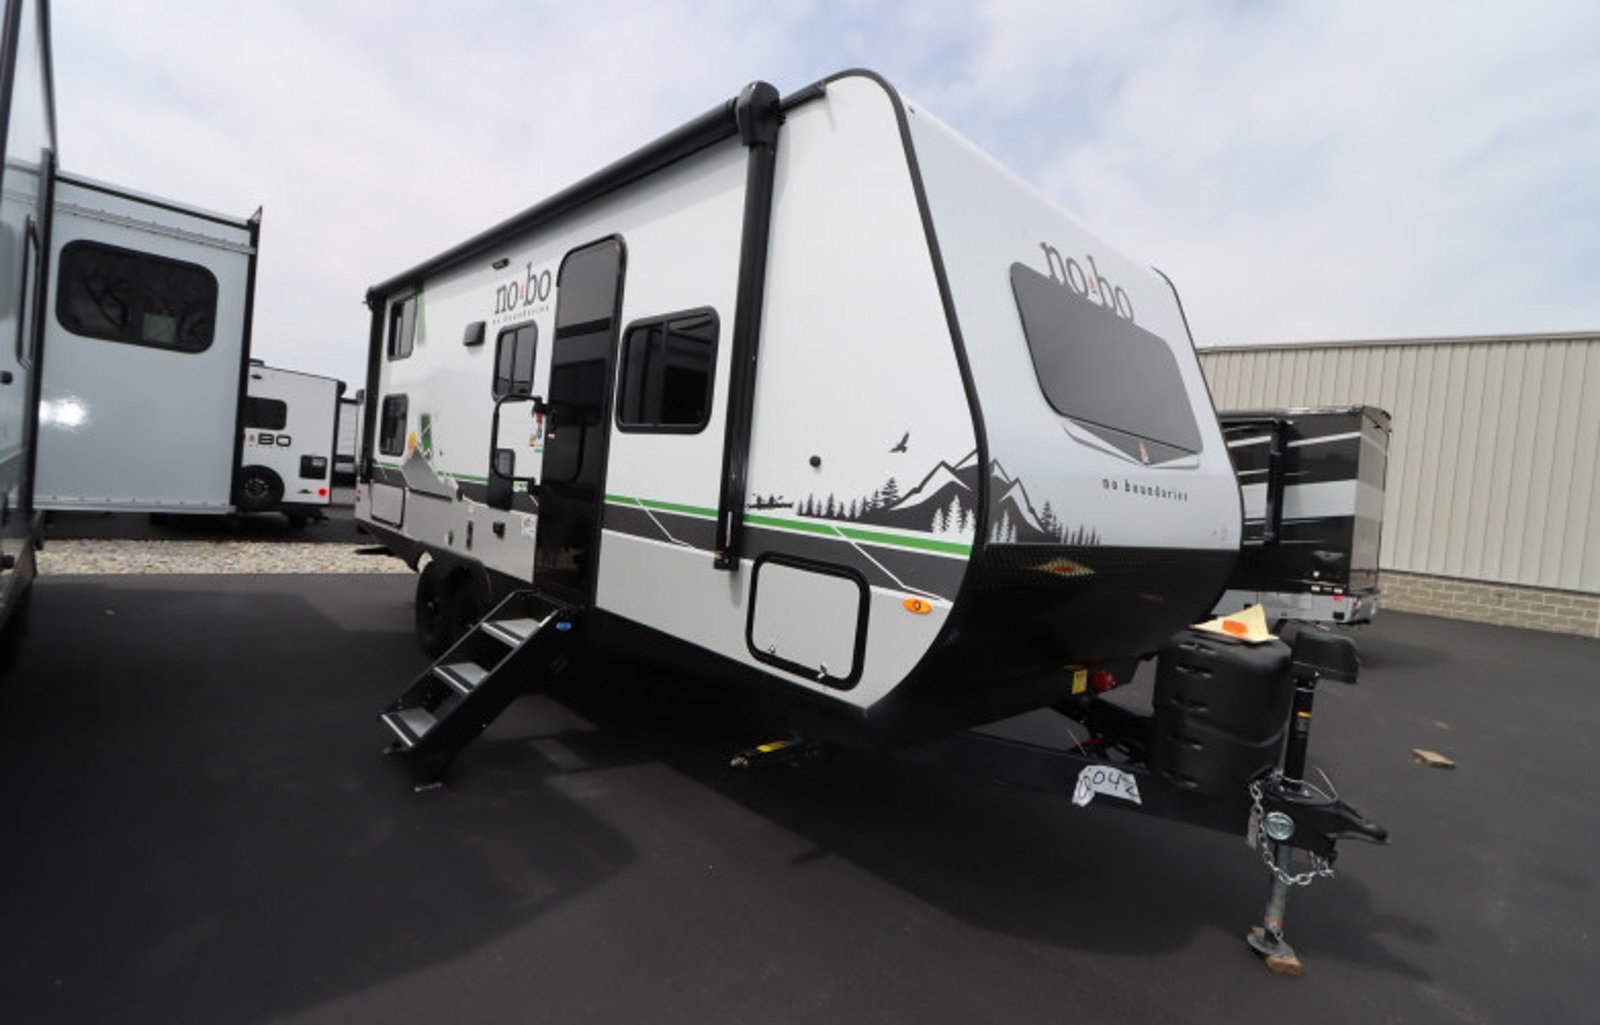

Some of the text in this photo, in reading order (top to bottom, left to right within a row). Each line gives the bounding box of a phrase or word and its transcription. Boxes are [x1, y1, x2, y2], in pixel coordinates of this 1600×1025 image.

[258, 433, 291, 447] BO
[1102, 478, 1188, 502] no boundaries
